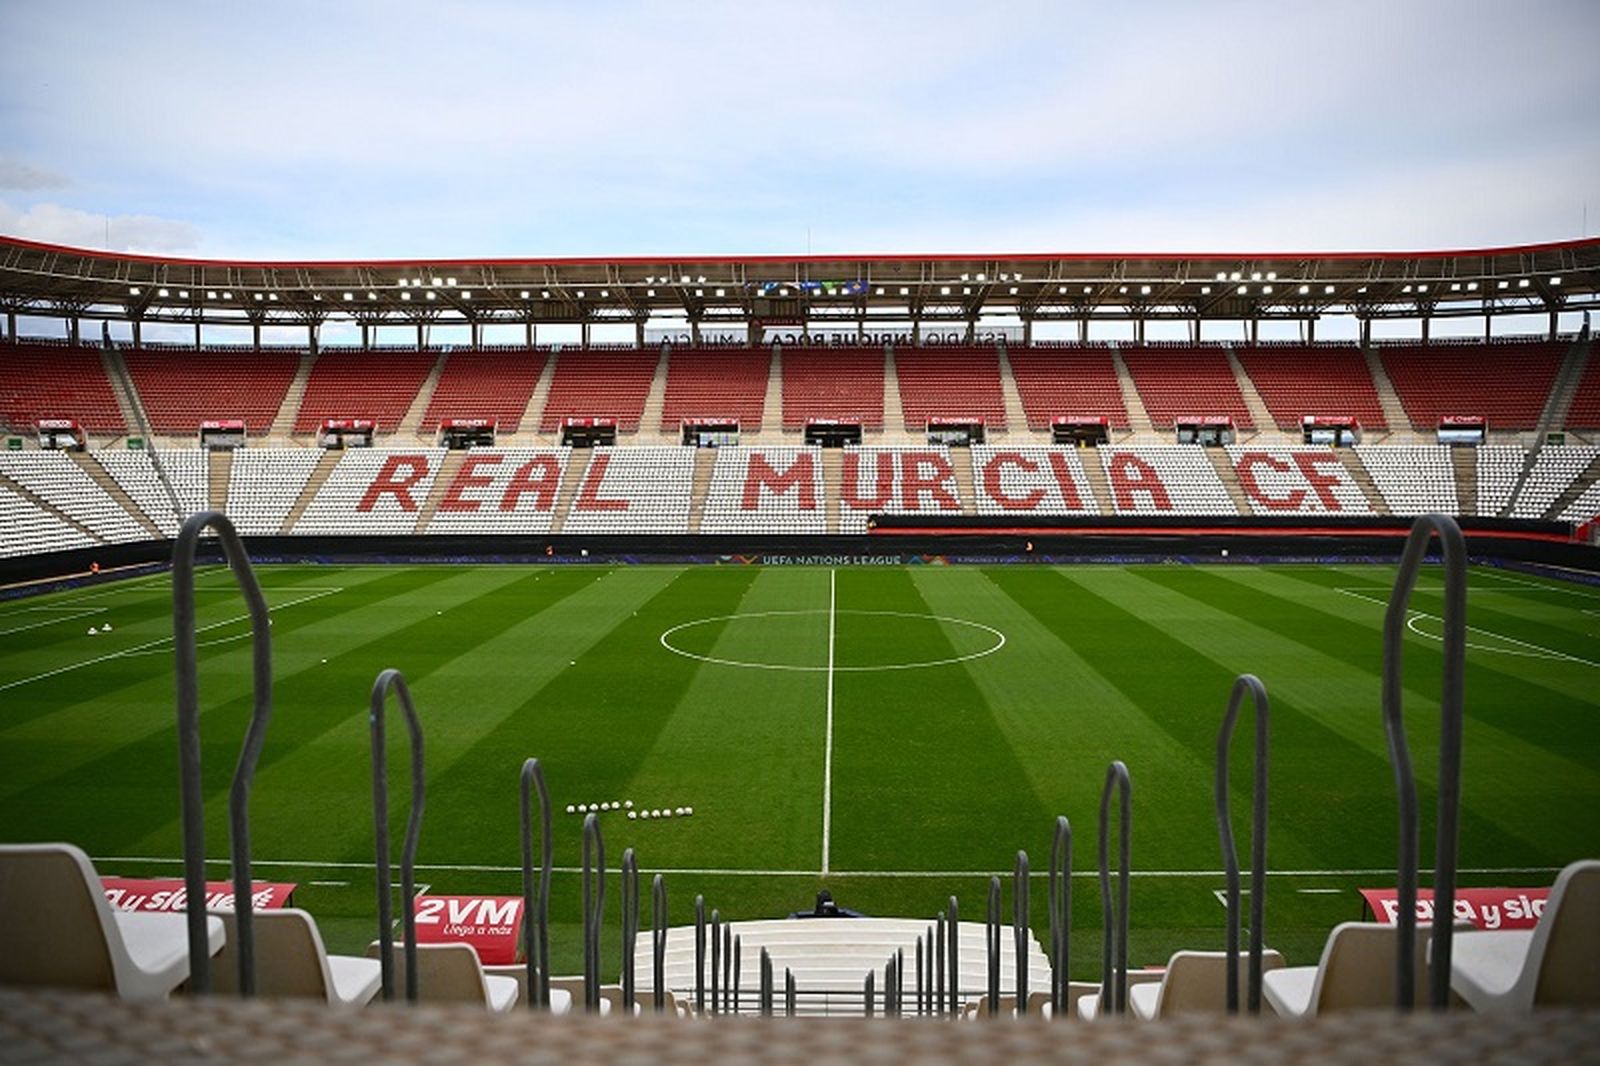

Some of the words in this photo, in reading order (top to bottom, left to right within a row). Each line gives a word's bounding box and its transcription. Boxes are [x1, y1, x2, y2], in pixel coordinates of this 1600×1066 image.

[356, 453, 630, 513] REAL
[740, 451, 1175, 511] MURCIA
[1235, 452, 1343, 512] CF
[763, 555, 793, 565] UEFA
[795, 555, 850, 565] NATIONS
[853, 555, 901, 565] LEAGUE
[414, 899, 520, 925] 2VM
[1481, 904, 1501, 929] y
